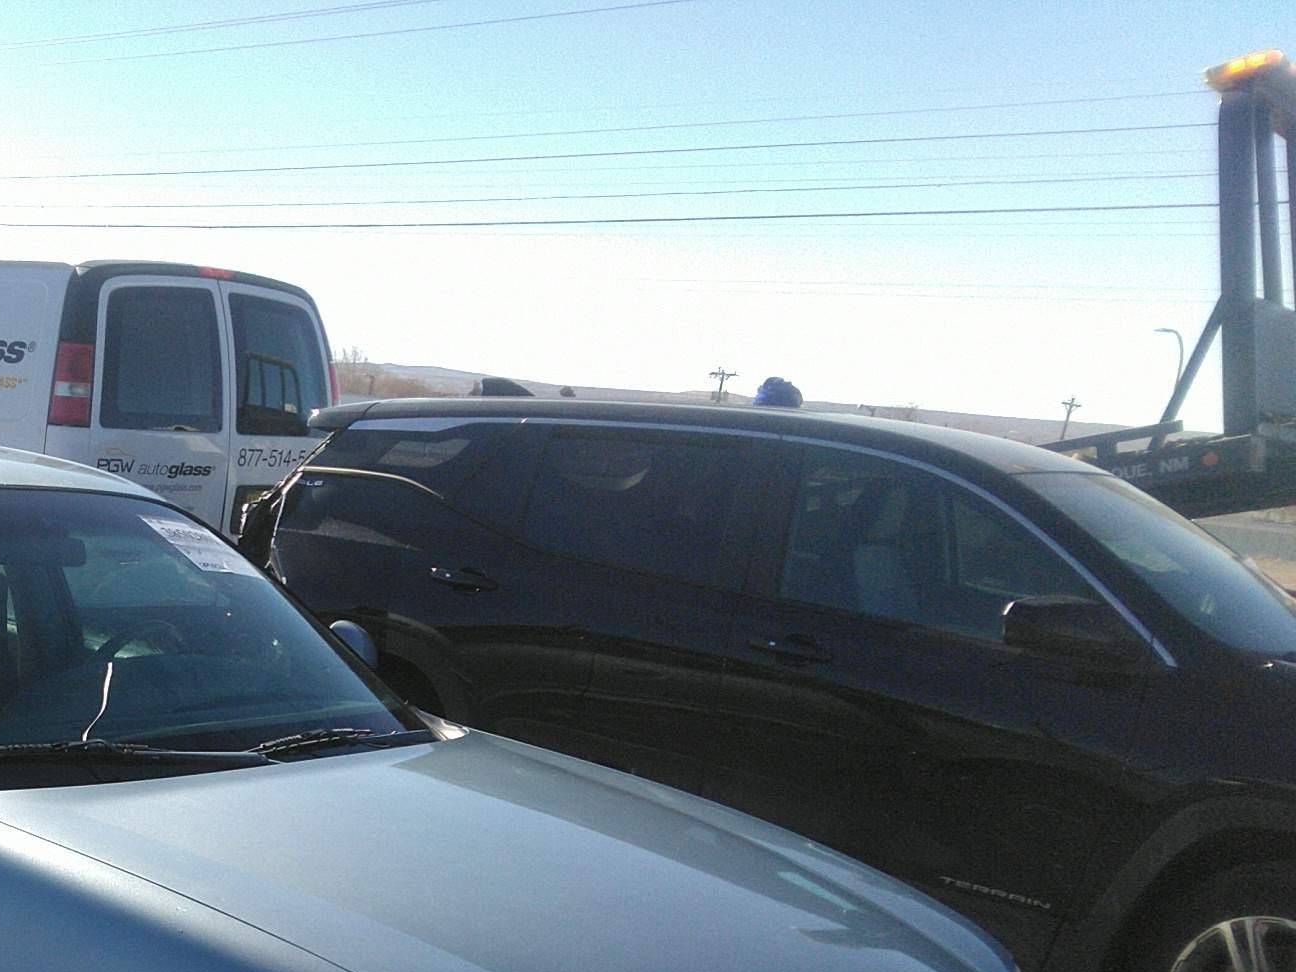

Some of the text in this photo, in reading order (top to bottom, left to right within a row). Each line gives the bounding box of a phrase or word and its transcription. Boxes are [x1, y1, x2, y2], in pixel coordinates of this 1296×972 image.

[96, 458, 136, 474] PGW
[1158, 456, 1191, 473] NM
[939, 875, 1052, 910] TERRAIN
